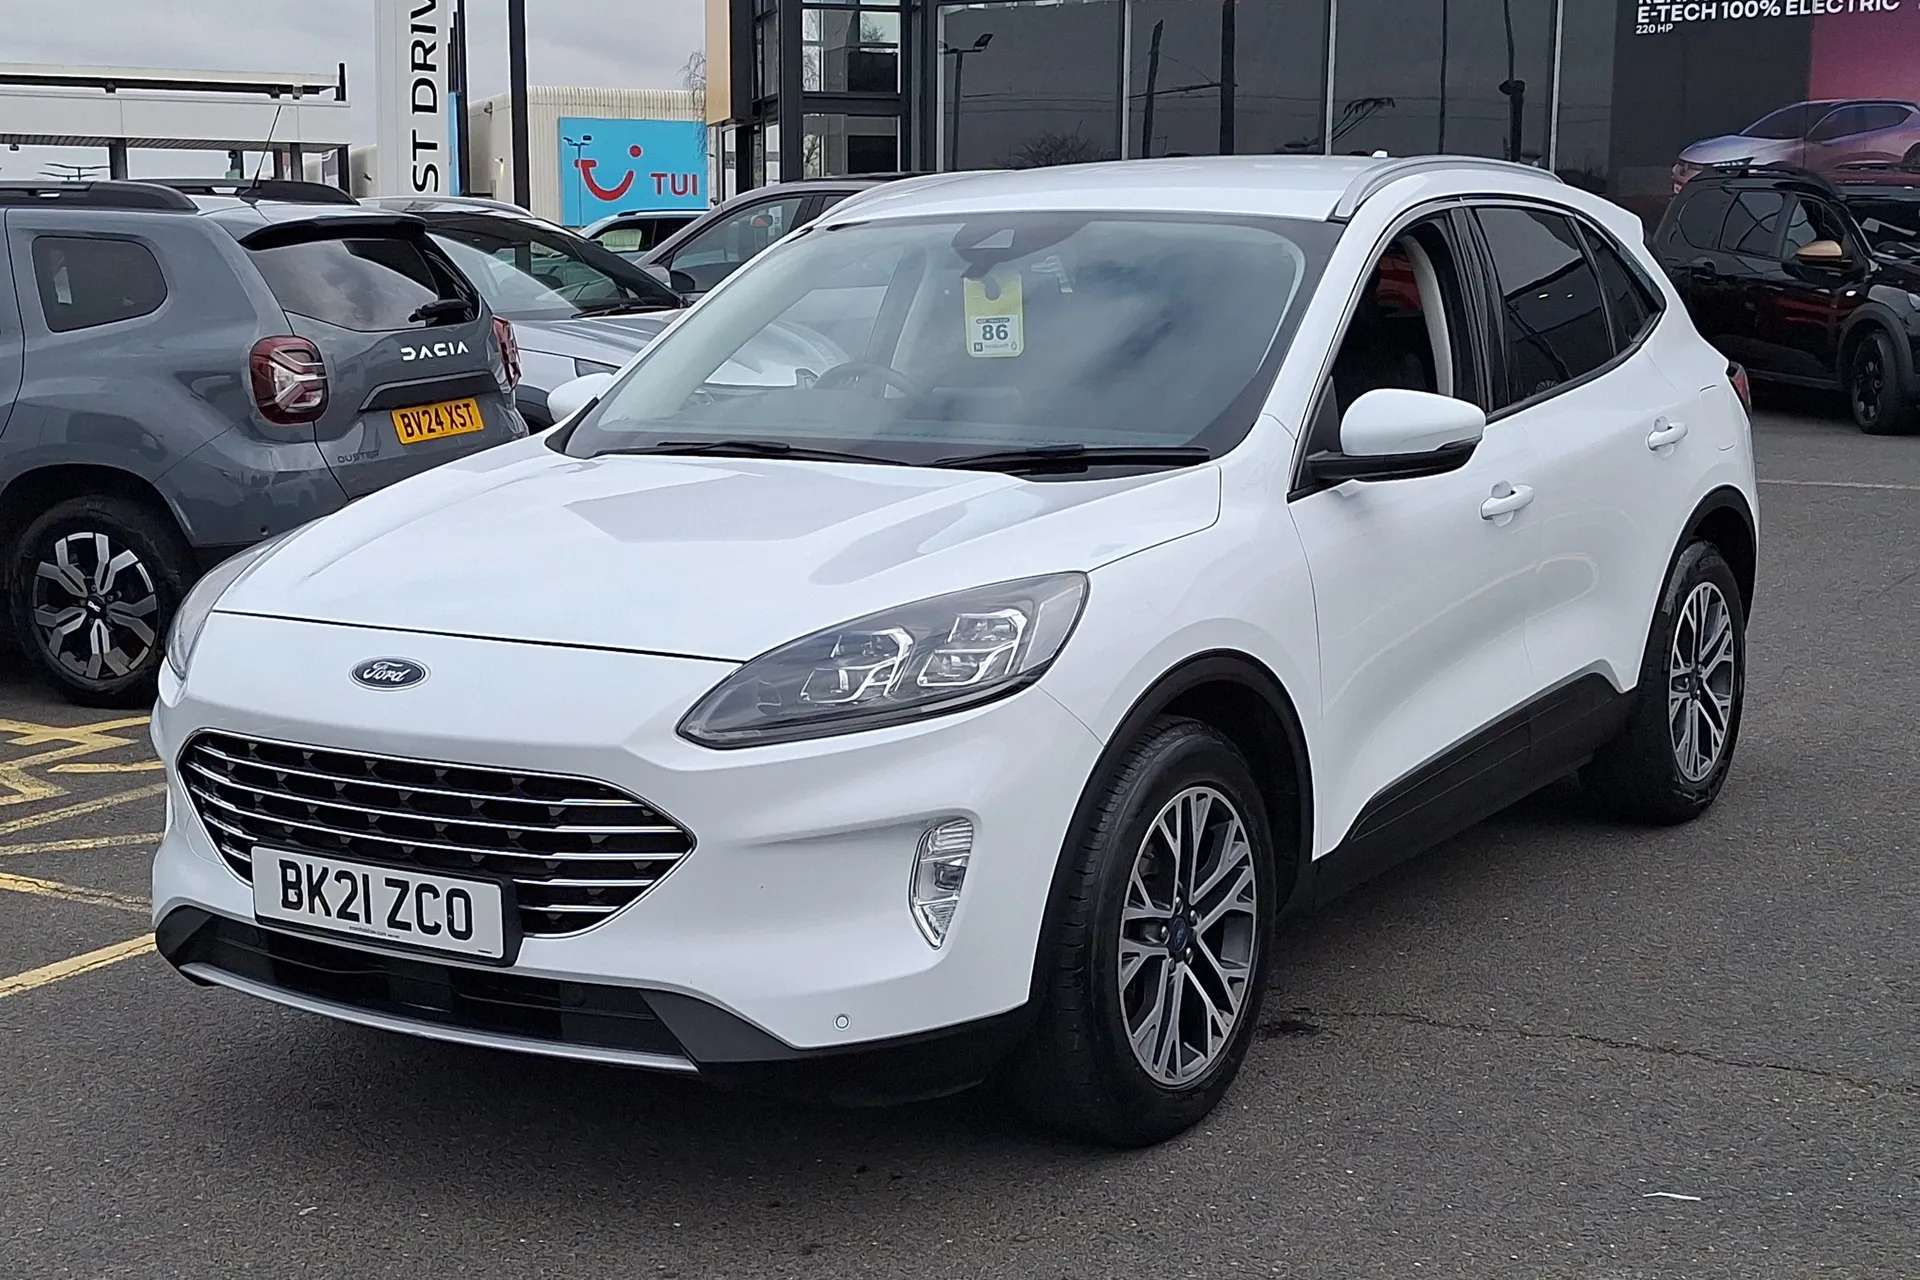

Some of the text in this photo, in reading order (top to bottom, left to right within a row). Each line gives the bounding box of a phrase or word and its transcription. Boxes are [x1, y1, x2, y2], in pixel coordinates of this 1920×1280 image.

[1637, 0, 1900, 24] E-TECH 100% ELECTRIC
[1635, 23, 1674, 35] 220 HP
[650, 173, 698, 196] TUI
[982, 324, 1009, 341] 86
[400, 341, 469, 361] DACIA
[399, 402, 475, 438] BV24 XST
[363, 661, 411, 682] Ford
[278, 859, 473, 941] BK21 ZCO
